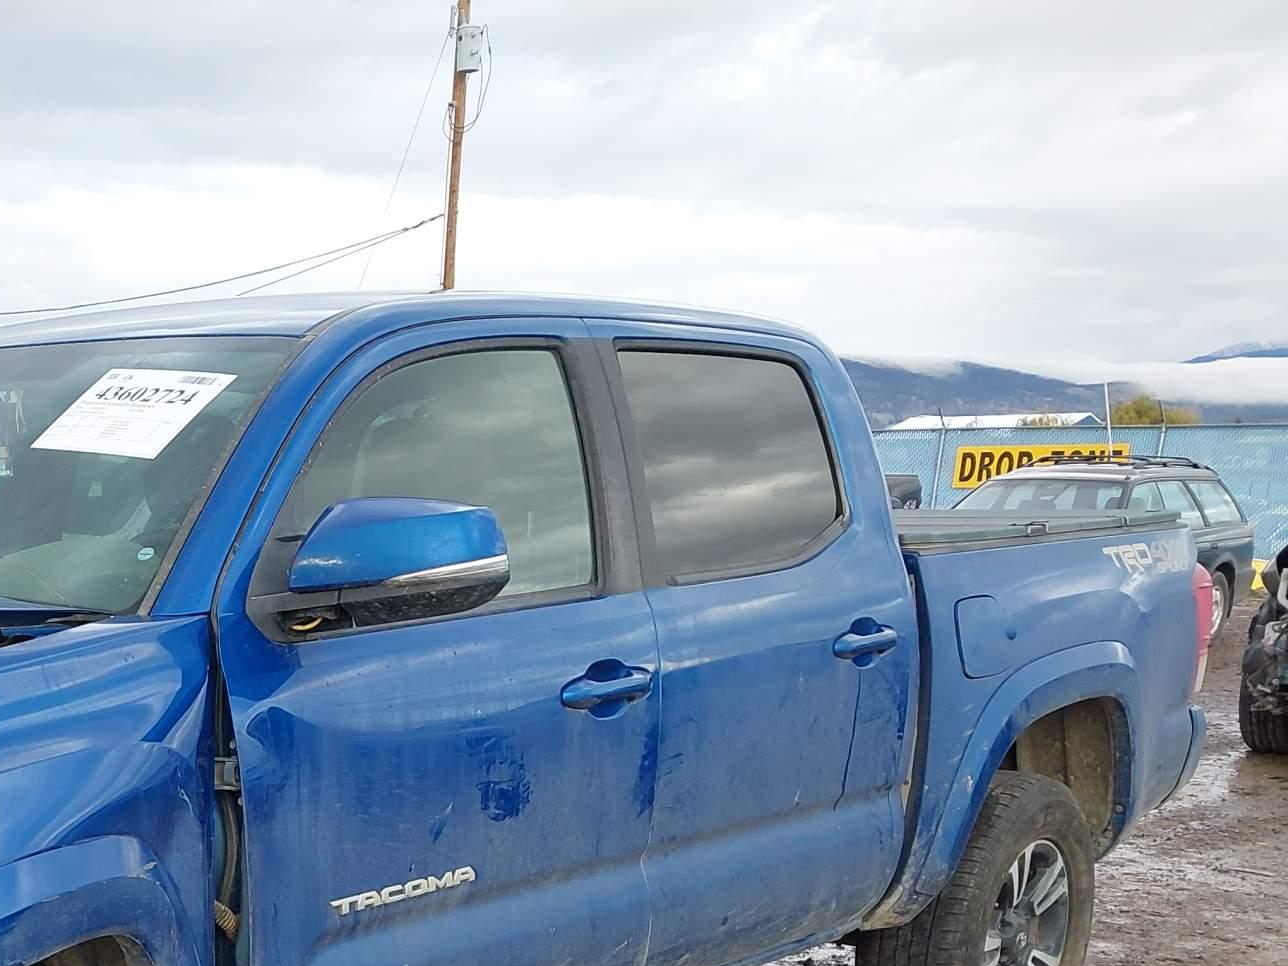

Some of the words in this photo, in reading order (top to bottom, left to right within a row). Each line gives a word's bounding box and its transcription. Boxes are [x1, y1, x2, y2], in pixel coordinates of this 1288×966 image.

[96, 386, 200, 405] 43602724
[959, 450, 1033, 482] DROP
[1102, 543, 1153, 573] TRD
[330, 866, 476, 915] TACOMA
